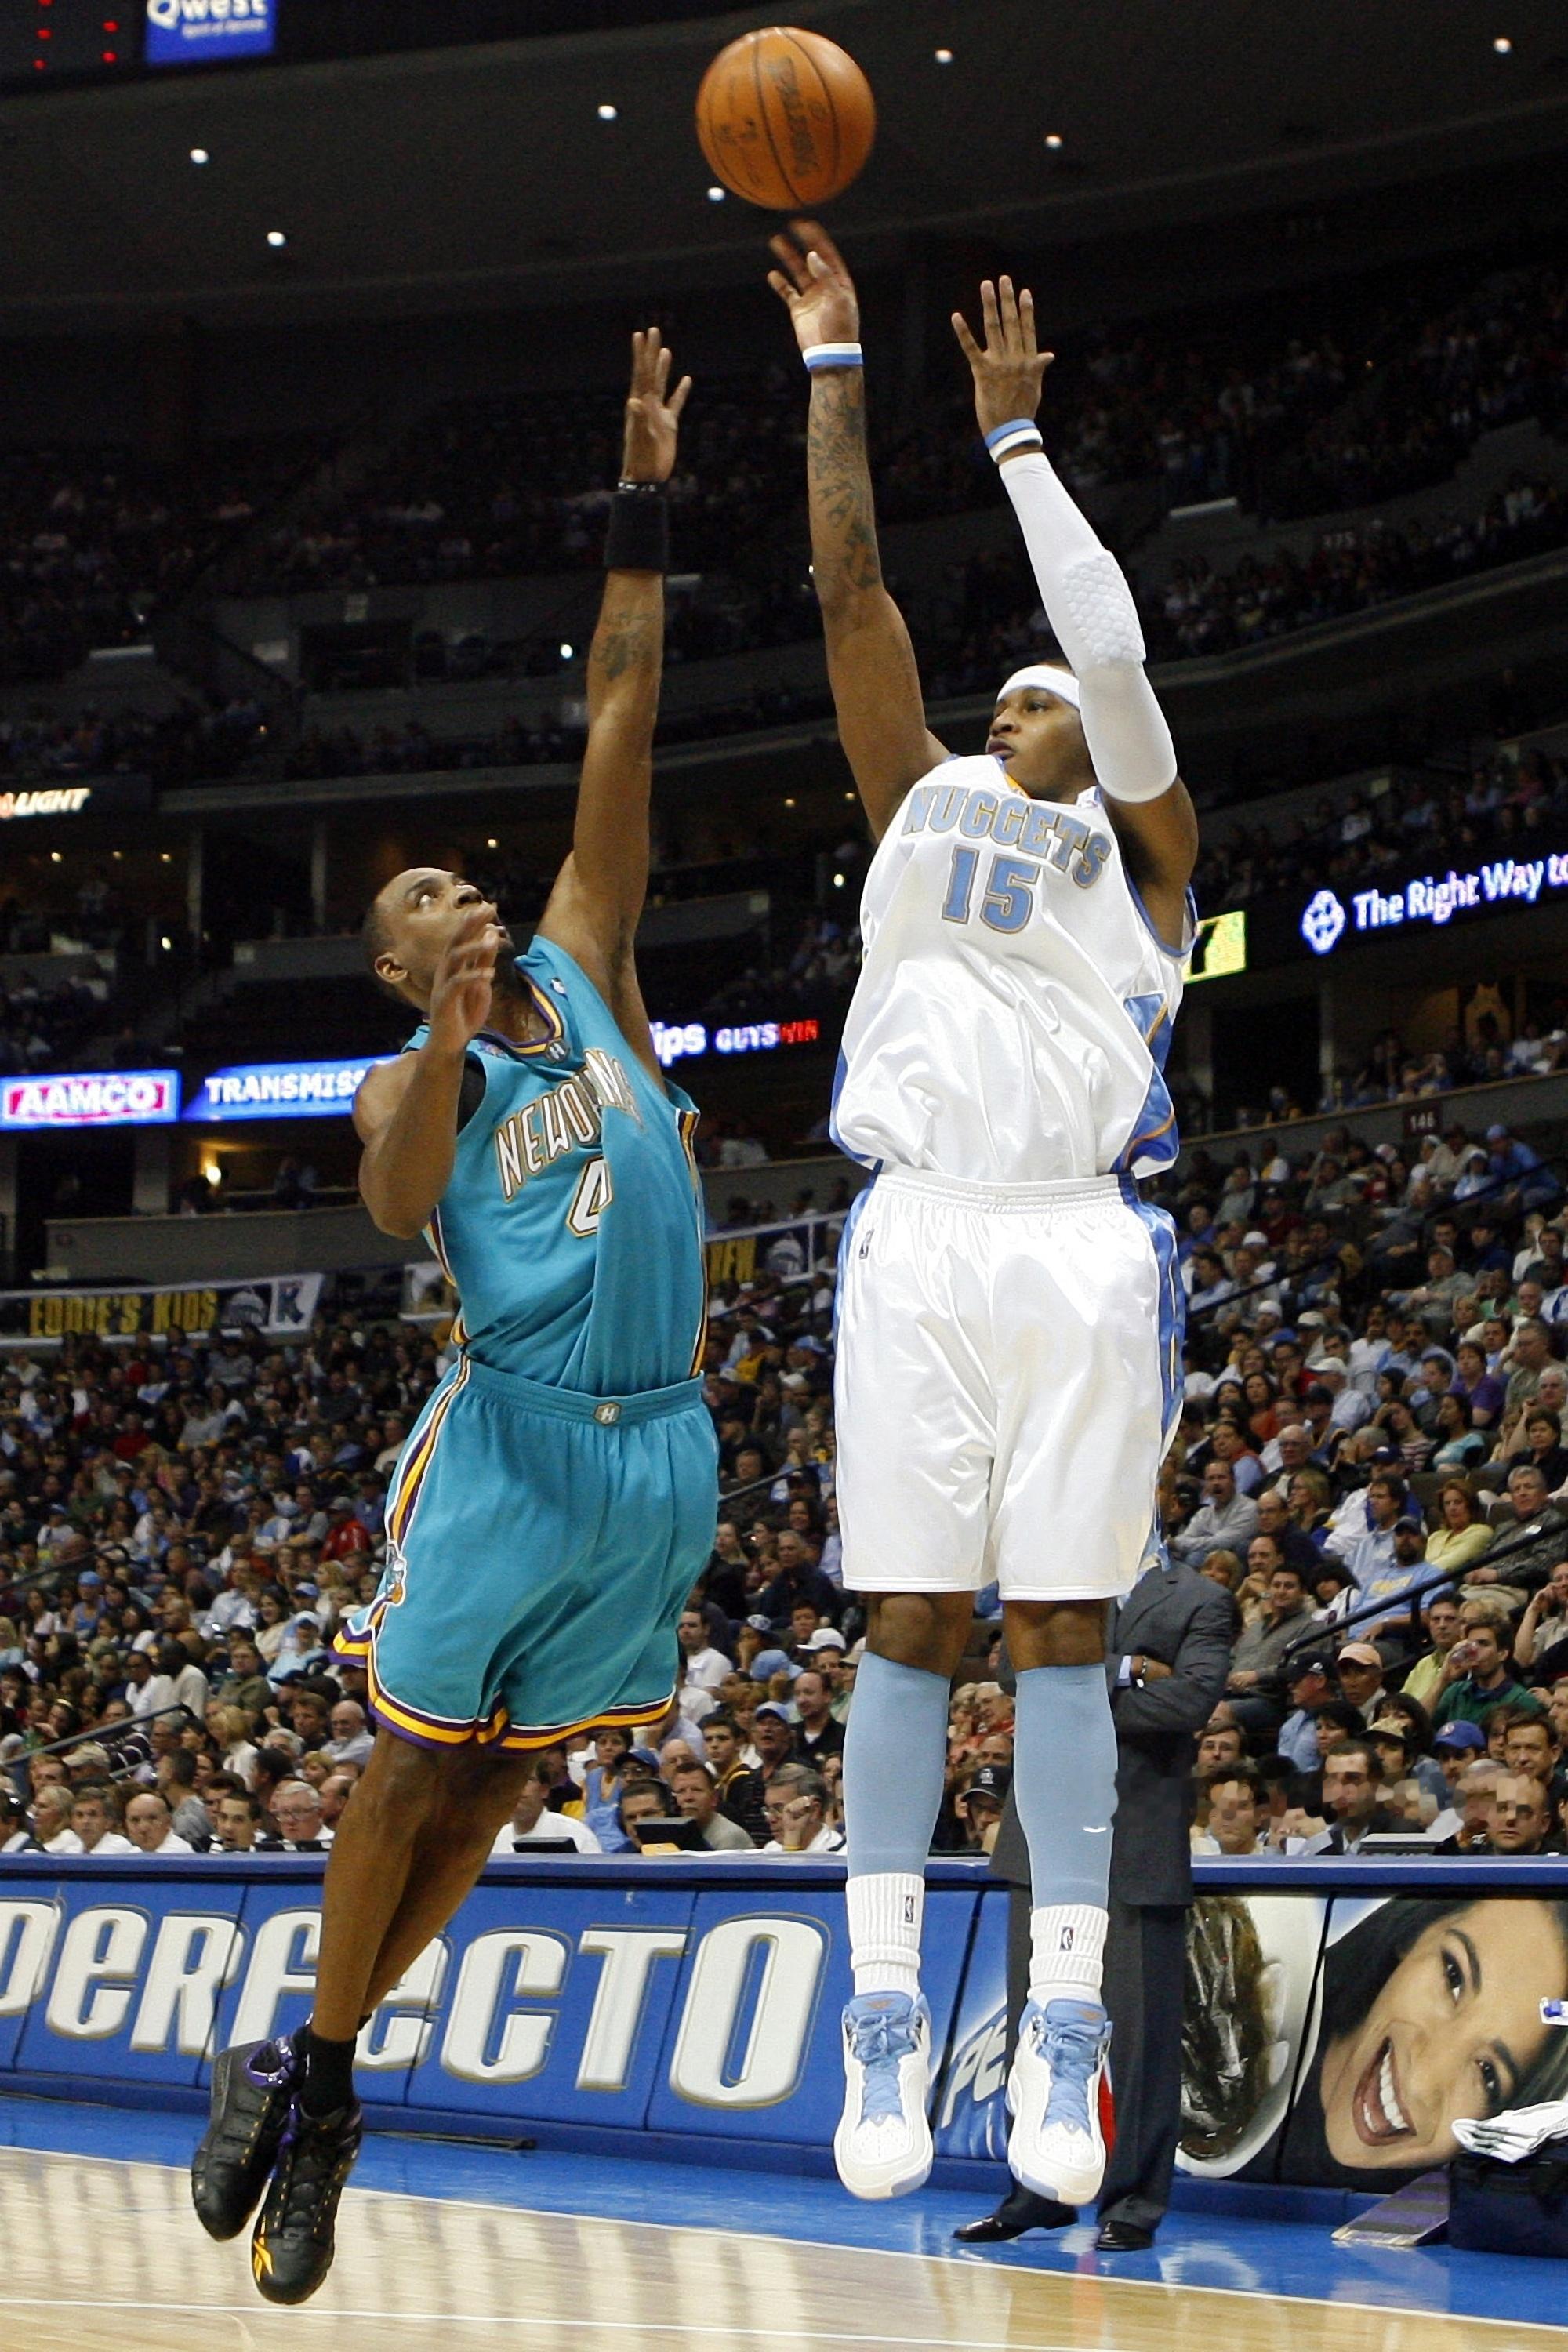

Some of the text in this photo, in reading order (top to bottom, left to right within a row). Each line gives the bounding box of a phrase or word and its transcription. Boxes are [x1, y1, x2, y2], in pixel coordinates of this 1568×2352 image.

[147, 0, 267, 29] Qwest
[14, 788, 91, 815] LIGHT
[900, 785, 1112, 889] NUGGETS
[941, 844, 1040, 934] 15
[1353, 889, 1404, 930] The
[1408, 871, 1480, 924] Right
[1481, 860, 1544, 902] Way
[17, 1077, 157, 1117] AAMCO
[29, 1290, 218, 1336] EDDIE'S KIDS
